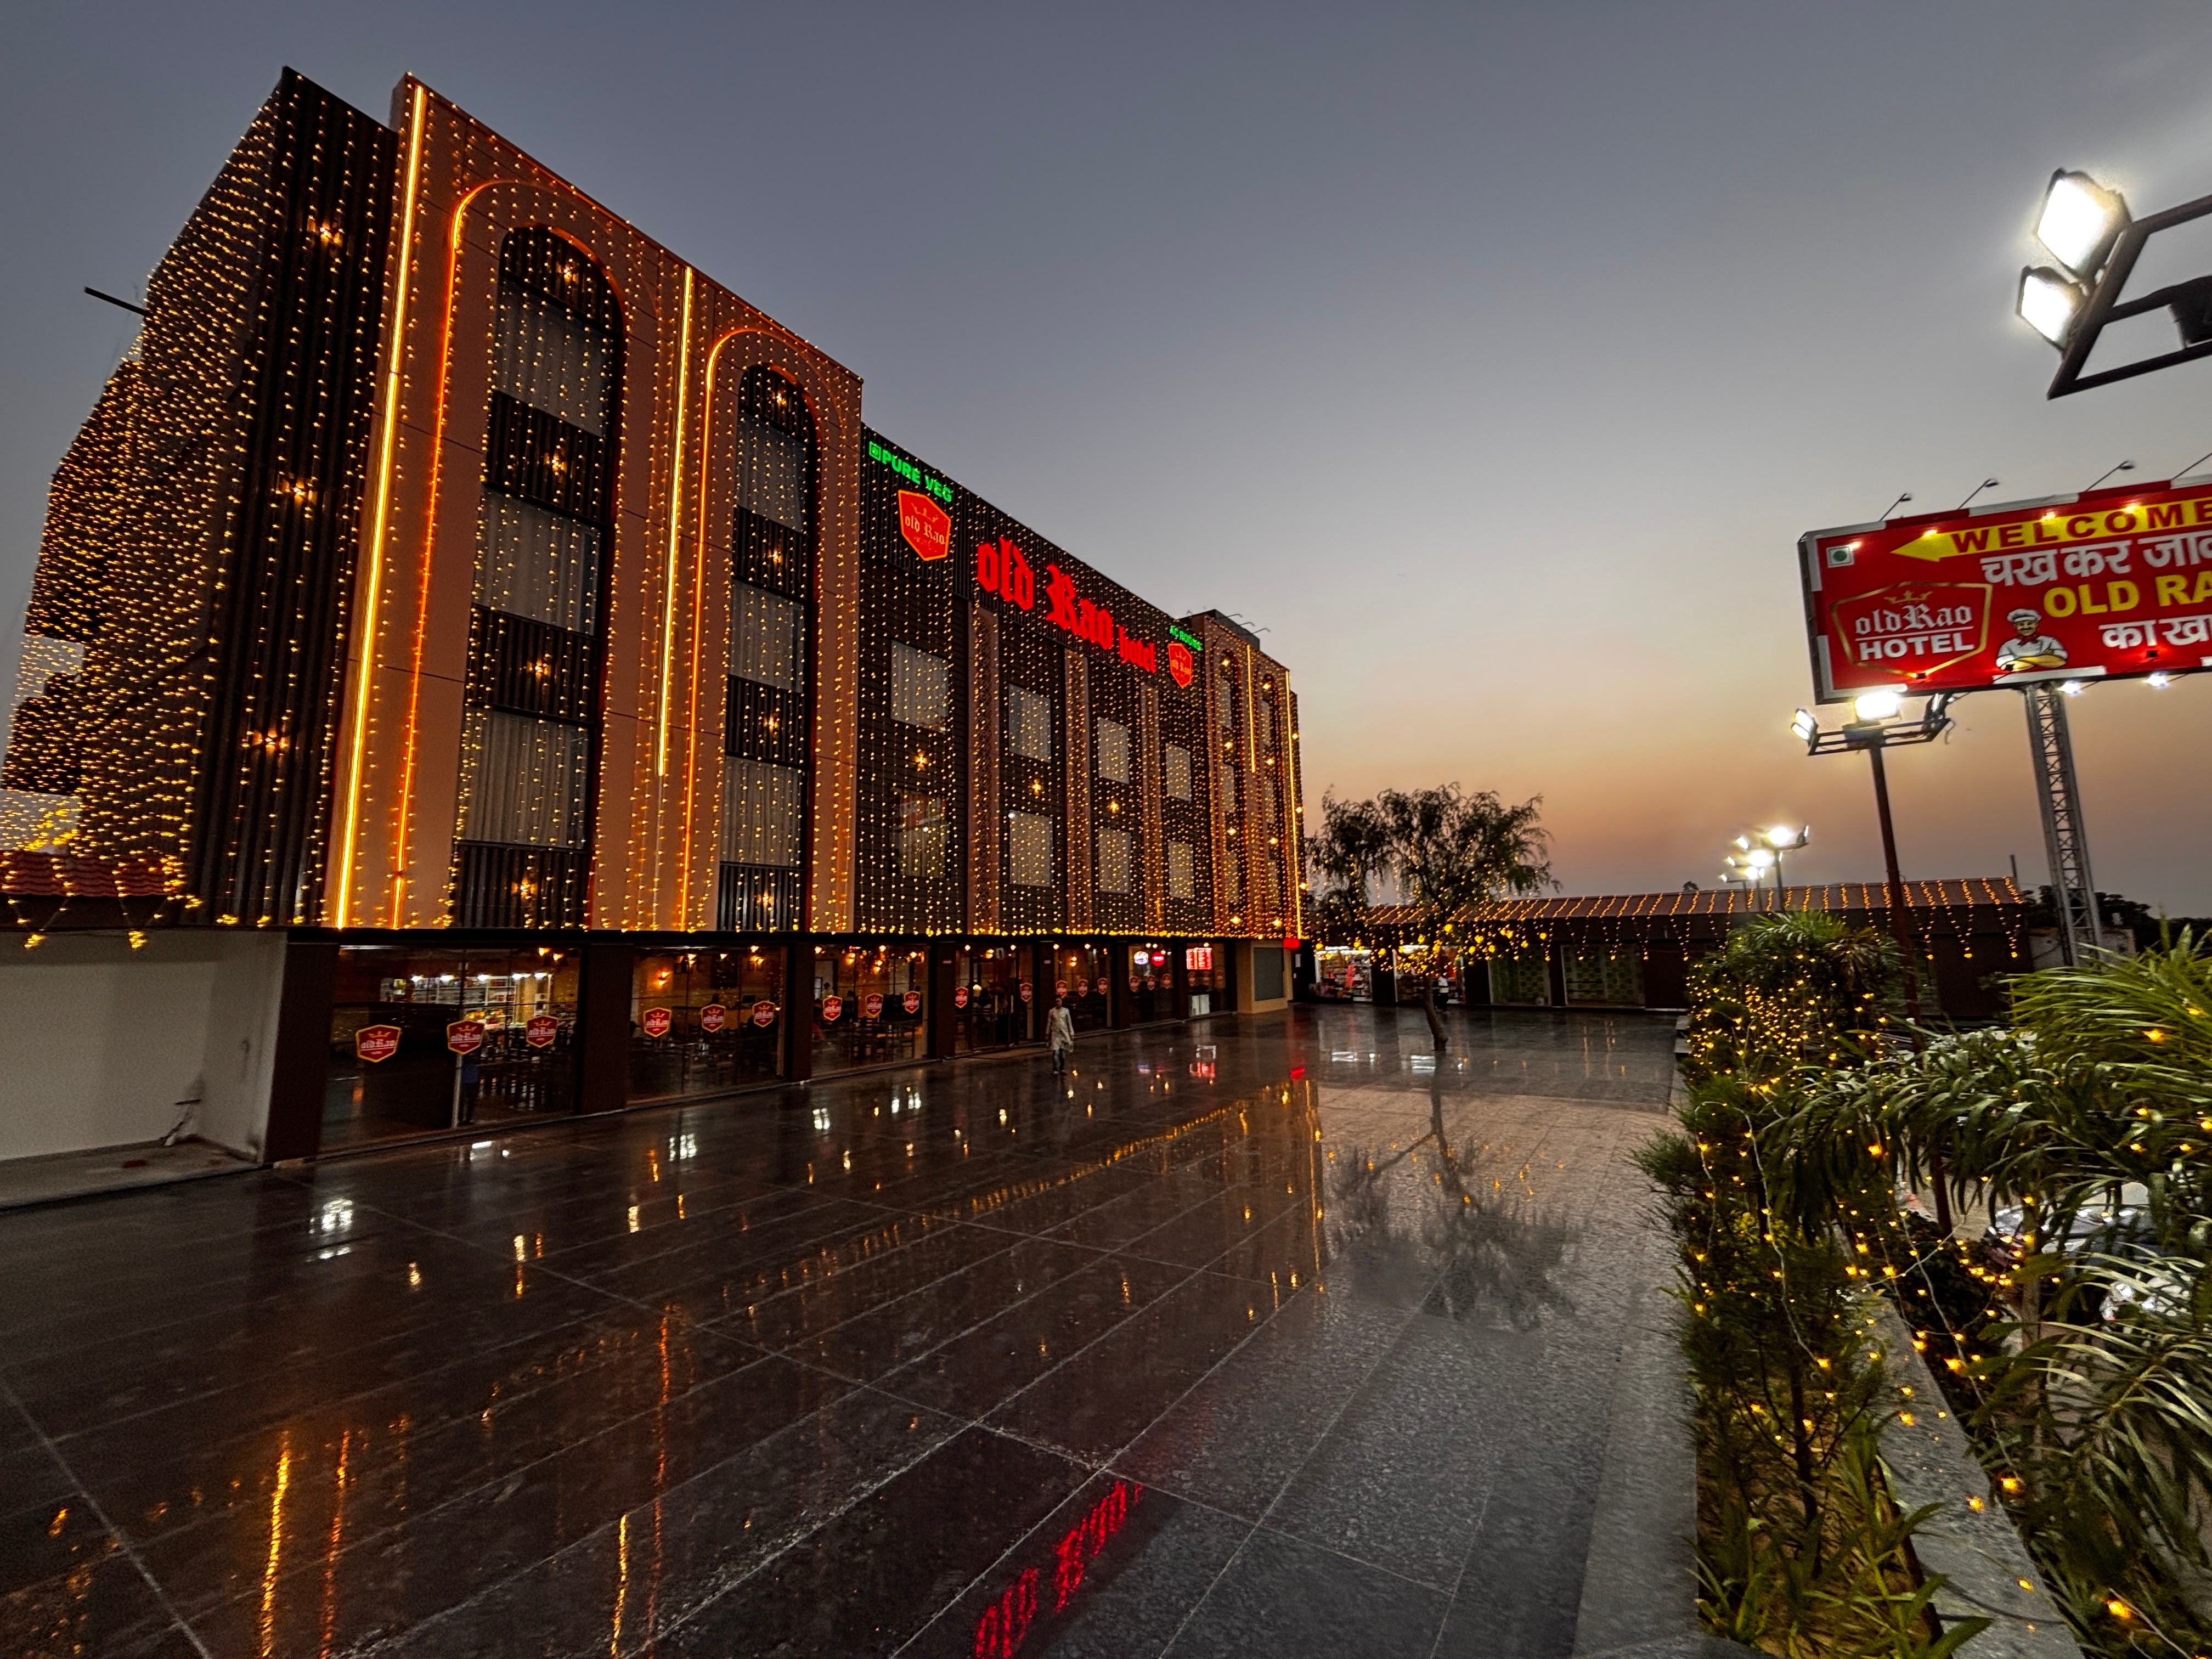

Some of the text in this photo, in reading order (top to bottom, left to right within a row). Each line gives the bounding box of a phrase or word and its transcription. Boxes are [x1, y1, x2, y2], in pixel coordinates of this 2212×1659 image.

[882, 449, 952, 503] PURE VEG
[905, 515, 920, 533] old
[1950, 500, 2212, 553] WELCOME
[977, 537, 1034, 611] old
[1046, 564, 1114, 650] Rao
[2044, 580, 2140, 618] OLD
[1859, 632, 1975, 661] HOTEL
[2098, 619, 2157, 649] का
